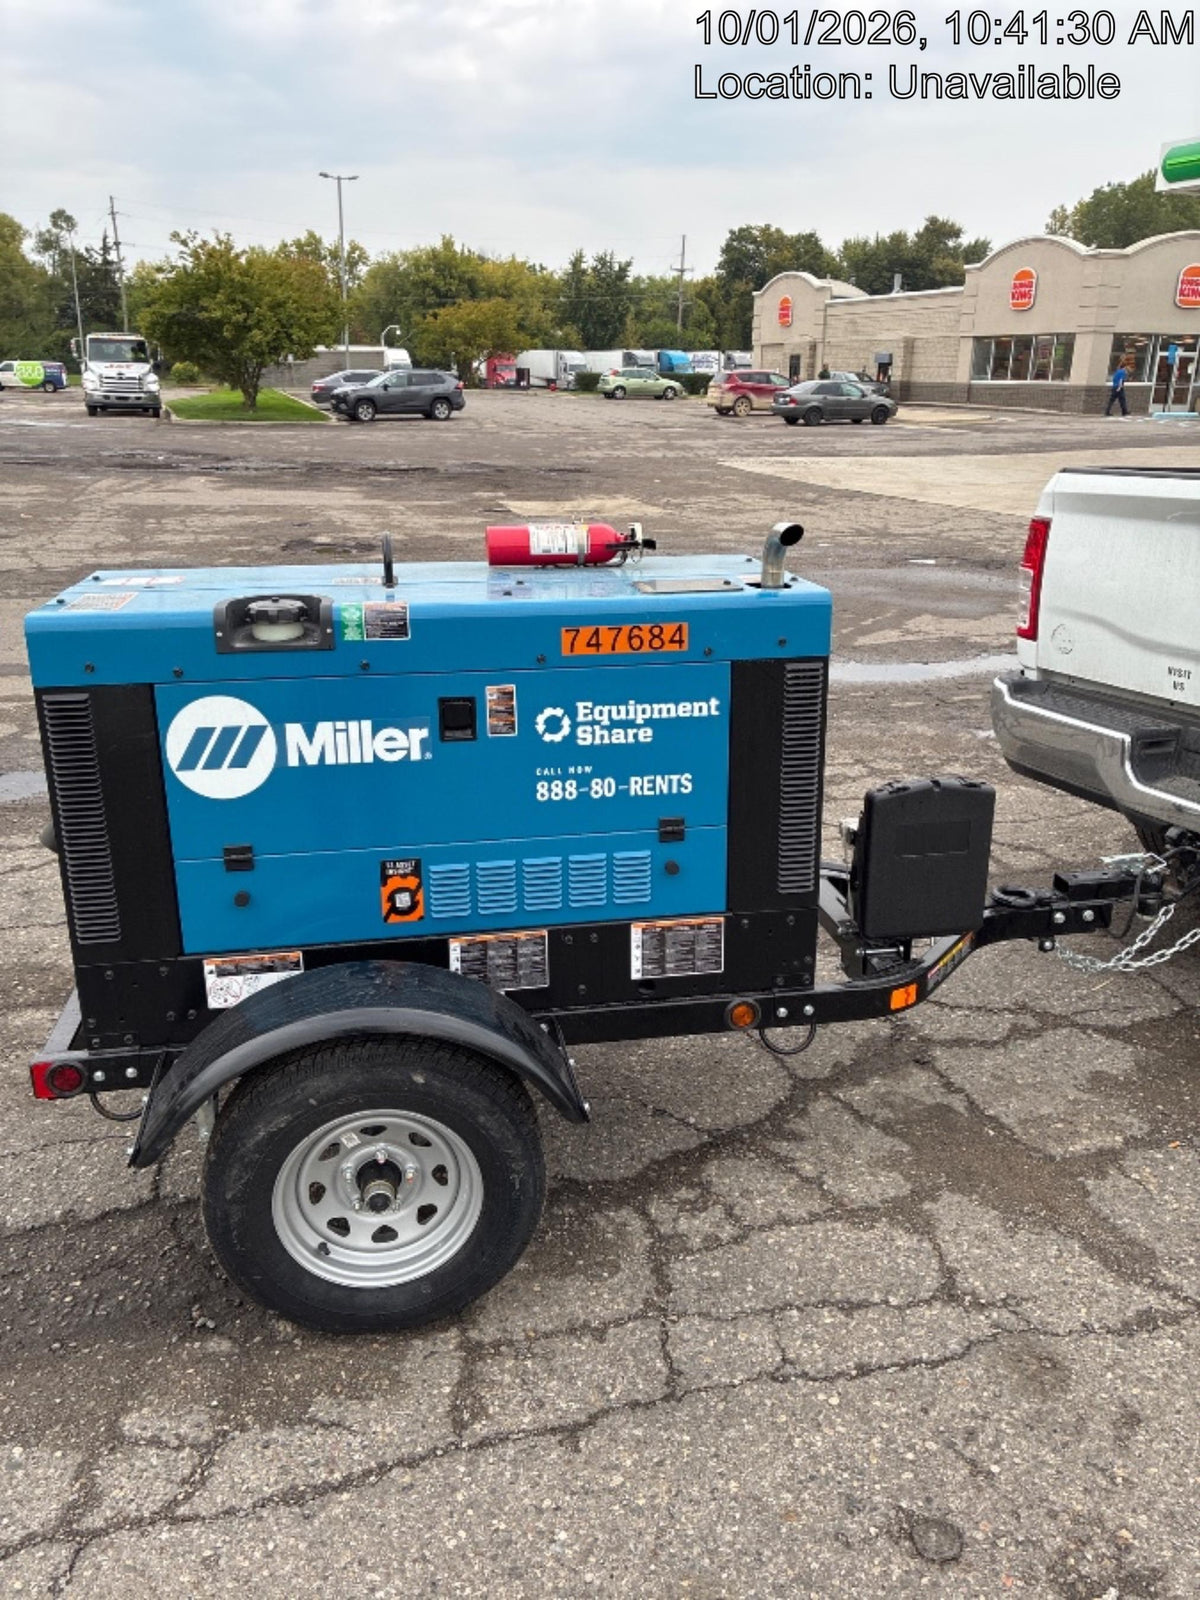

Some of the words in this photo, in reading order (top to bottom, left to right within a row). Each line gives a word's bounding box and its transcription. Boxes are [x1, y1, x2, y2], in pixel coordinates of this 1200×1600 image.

[564, 623, 686, 653] 747684
[1168, 666, 1192, 680] VISIT
[1173, 681, 1185, 691] US
[576, 697, 721, 726] Equipment
[285, 719, 429, 767] Miller
[576, 725, 653, 746] Share
[536, 767, 562, 776] CALL
[568, 766, 593, 775] NOW
[536, 773, 693, 802] 888-80-RENTS
